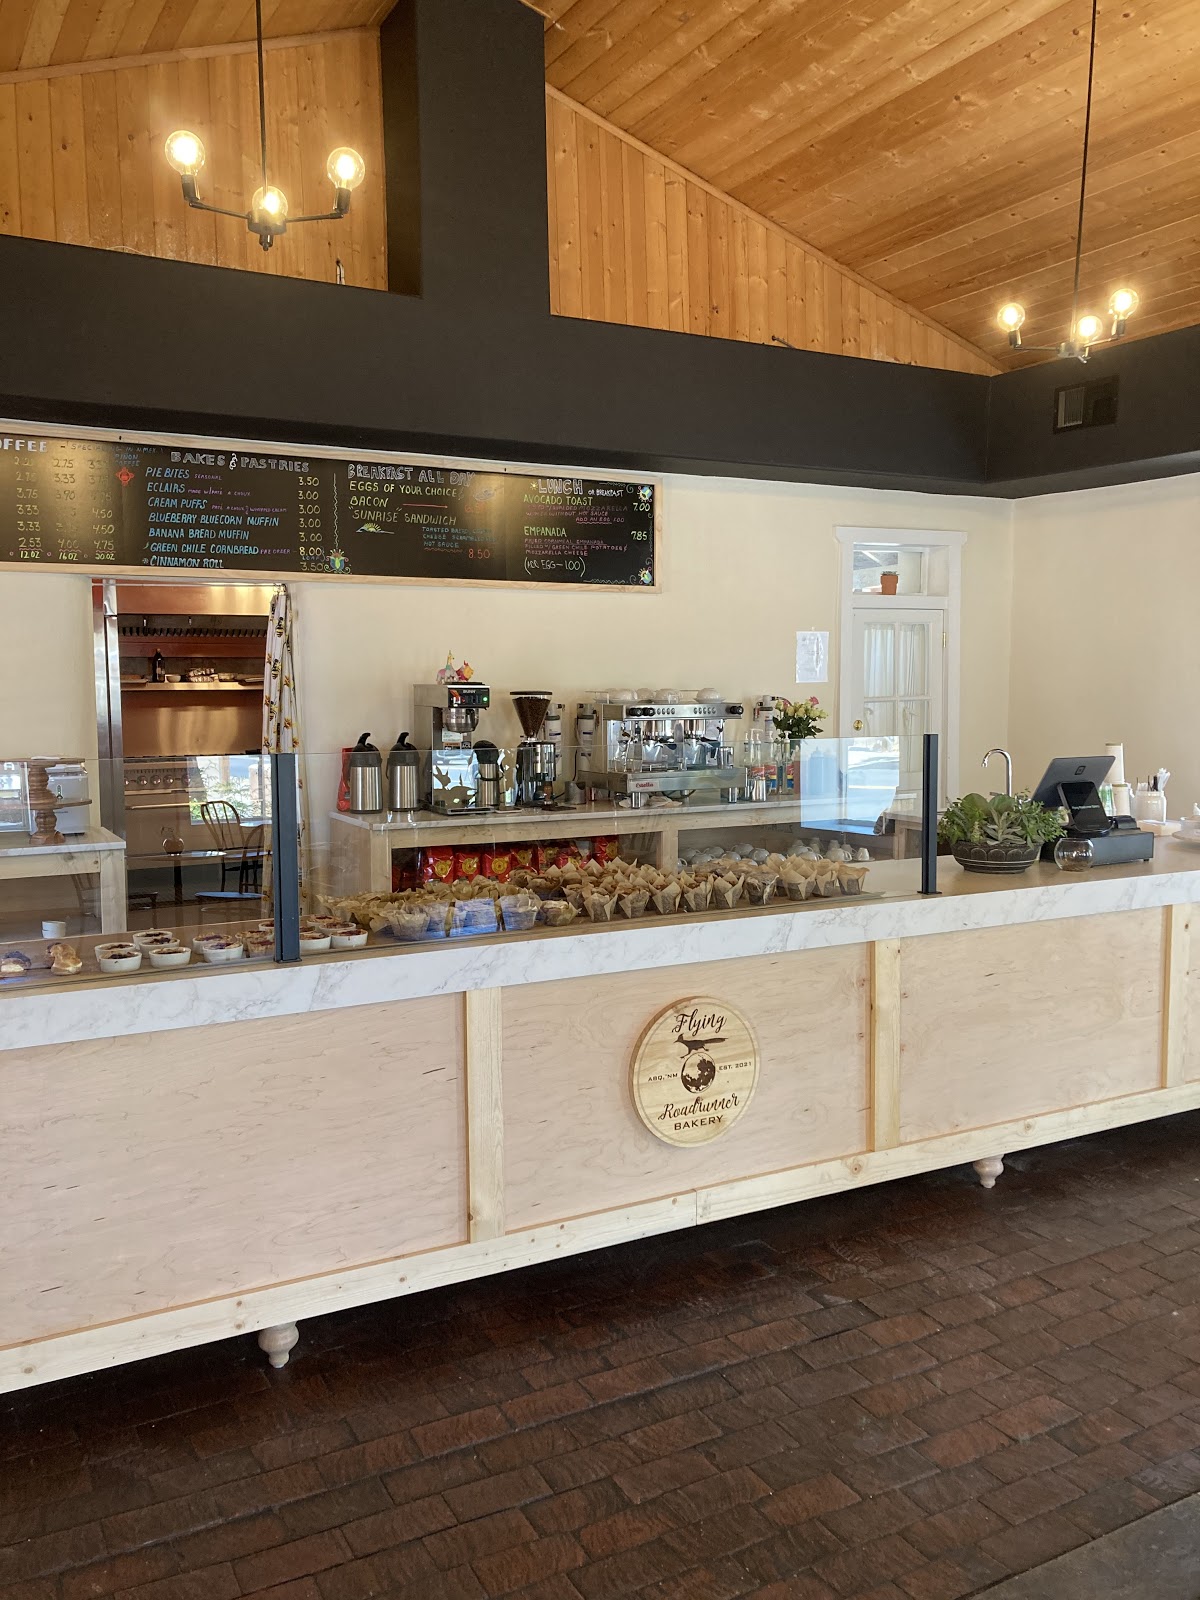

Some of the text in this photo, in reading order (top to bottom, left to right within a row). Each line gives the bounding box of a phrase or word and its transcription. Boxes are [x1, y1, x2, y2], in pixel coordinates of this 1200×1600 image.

[170, 451, 226, 466] BAKES
[240, 456, 310, 473] PASTRIES
[53, 473, 76, 484] 3.33
[145, 466, 163, 478] PIE
[163, 467, 191, 479] BITES
[298, 476, 320, 487] 3.50
[347, 463, 414, 481] BREAKFAST
[418, 469, 445, 484] ALL
[16, 487, 39, 499] 3.75
[146, 481, 186, 494] ECLAIRS
[298, 490, 319, 501] 3.00
[349, 480, 379, 492] EGGS
[383, 483, 396, 494] OF
[400, 484, 422, 496] YOUR
[424, 486, 458, 498] CHOICE
[537, 478, 584, 495] LUNCH
[147, 496, 178, 509] CREAM
[180, 499, 208, 511] PUFFS
[298, 504, 321, 515] 3.00
[349, 495, 389, 508] BACON
[523, 494, 651, 512] AVOCADO TOAST 7.00
[16, 504, 113, 519] 3.33 4.50
[404, 513, 458, 526] SANDWICH
[17, 521, 41, 532] 3.33
[92, 524, 115, 535] 4.50
[148, 512, 198, 524] BLUEBERRY
[246, 516, 280, 527] MUFFIN
[299, 518, 322, 529] 3.00
[148, 528, 323, 542] BANANA BREAD MUFFIN 3.00
[523, 526, 649, 541] EMPANADA 7.85
[93, 539, 115, 551] 4.75
[150, 542, 178, 553] GREEN
[181, 544, 207, 555] CHILE
[209, 545, 260, 556] CORNBREAD
[299, 546, 322, 557] 8.00
[468, 548, 491, 560] 8.50
[149, 555, 324, 572] CINNAMON ROLL 3.50
[671, 1008, 728, 1037] Flying
[735, 1061, 753, 1069] 2021
[657, 1092, 740, 1121] Roadrunner
[673, 1114, 724, 1131] BAKERY
